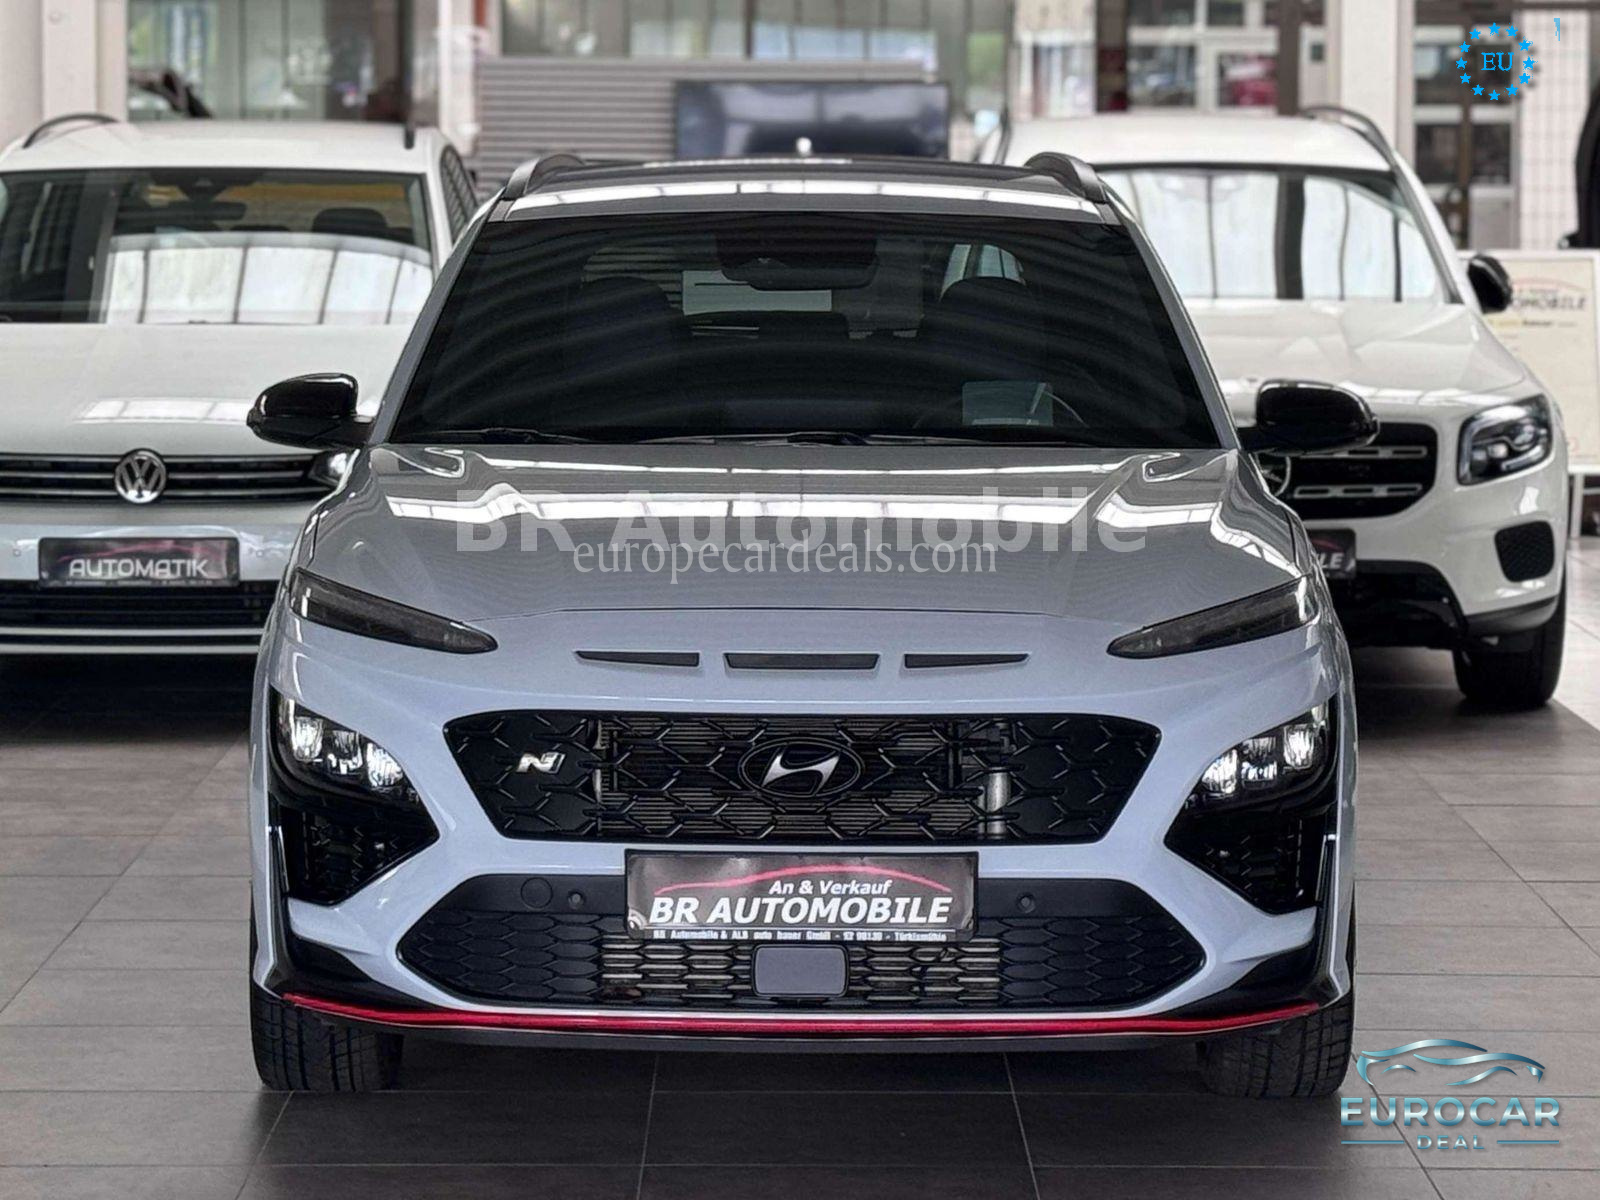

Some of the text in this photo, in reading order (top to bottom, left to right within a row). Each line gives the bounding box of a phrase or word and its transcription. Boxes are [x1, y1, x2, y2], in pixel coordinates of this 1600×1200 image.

[69, 558, 208, 577] AUTOMATIK
[768, 880, 893, 895] An & Verkauf
[649, 896, 953, 924] BR AUTOMOBILE
